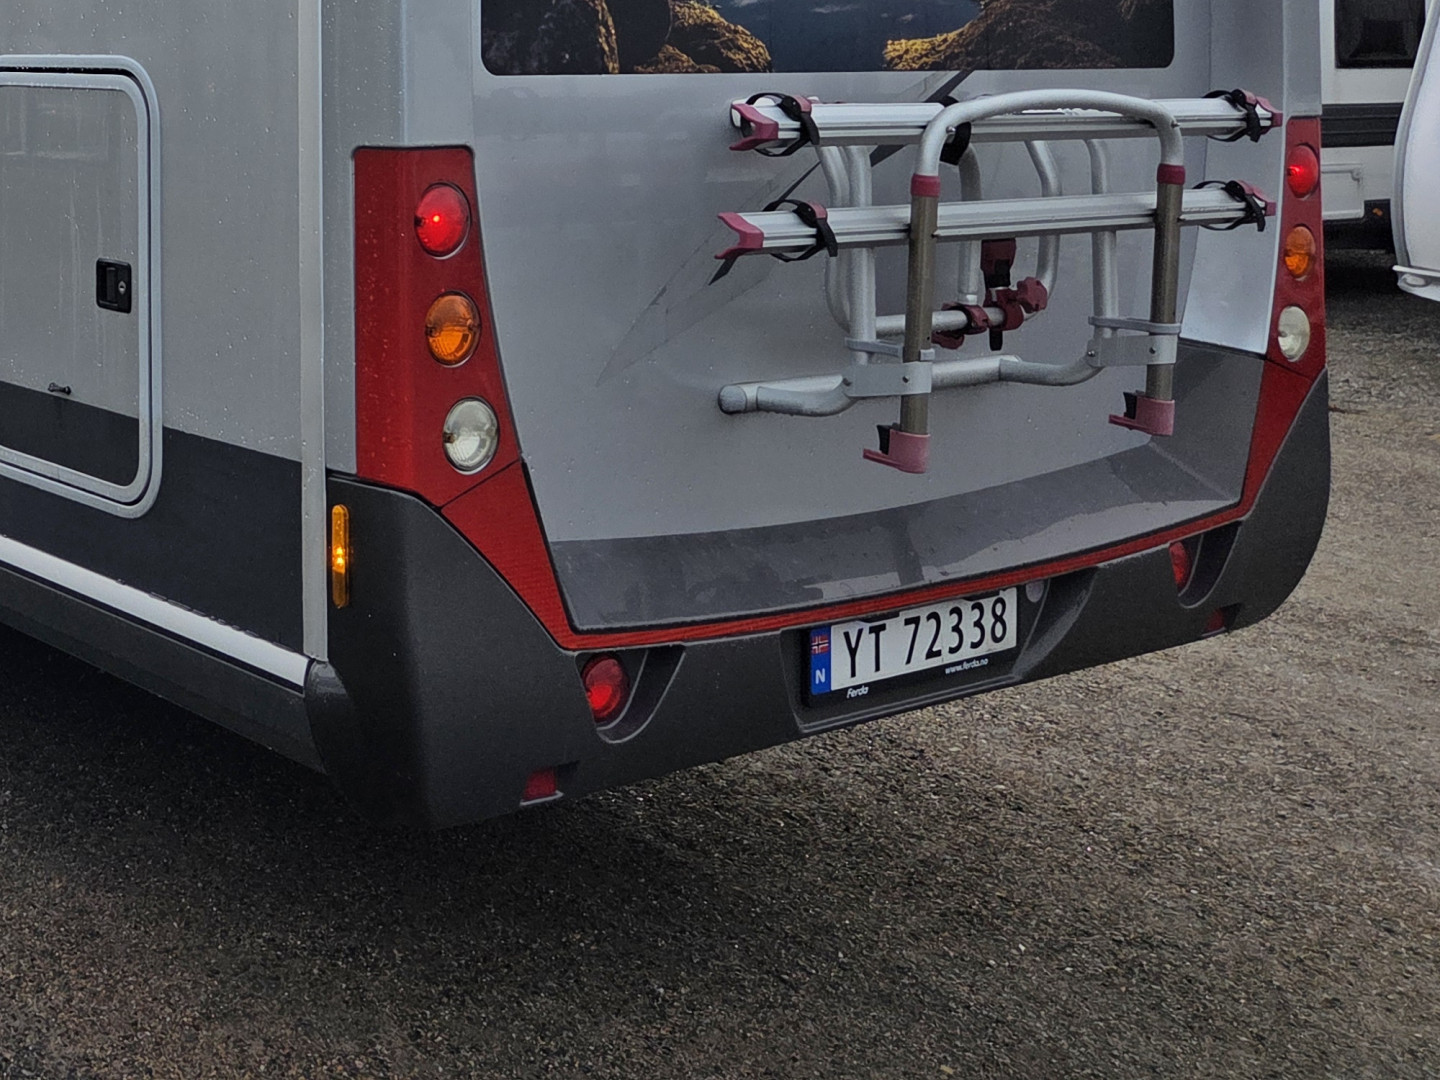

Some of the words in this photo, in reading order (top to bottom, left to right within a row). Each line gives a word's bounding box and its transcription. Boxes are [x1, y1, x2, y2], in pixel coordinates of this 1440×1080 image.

[843, 623, 887, 678] YT
[904, 597, 1008, 665] 72338
[815, 668, 826, 684] N
[846, 685, 869, 699] Ferda
